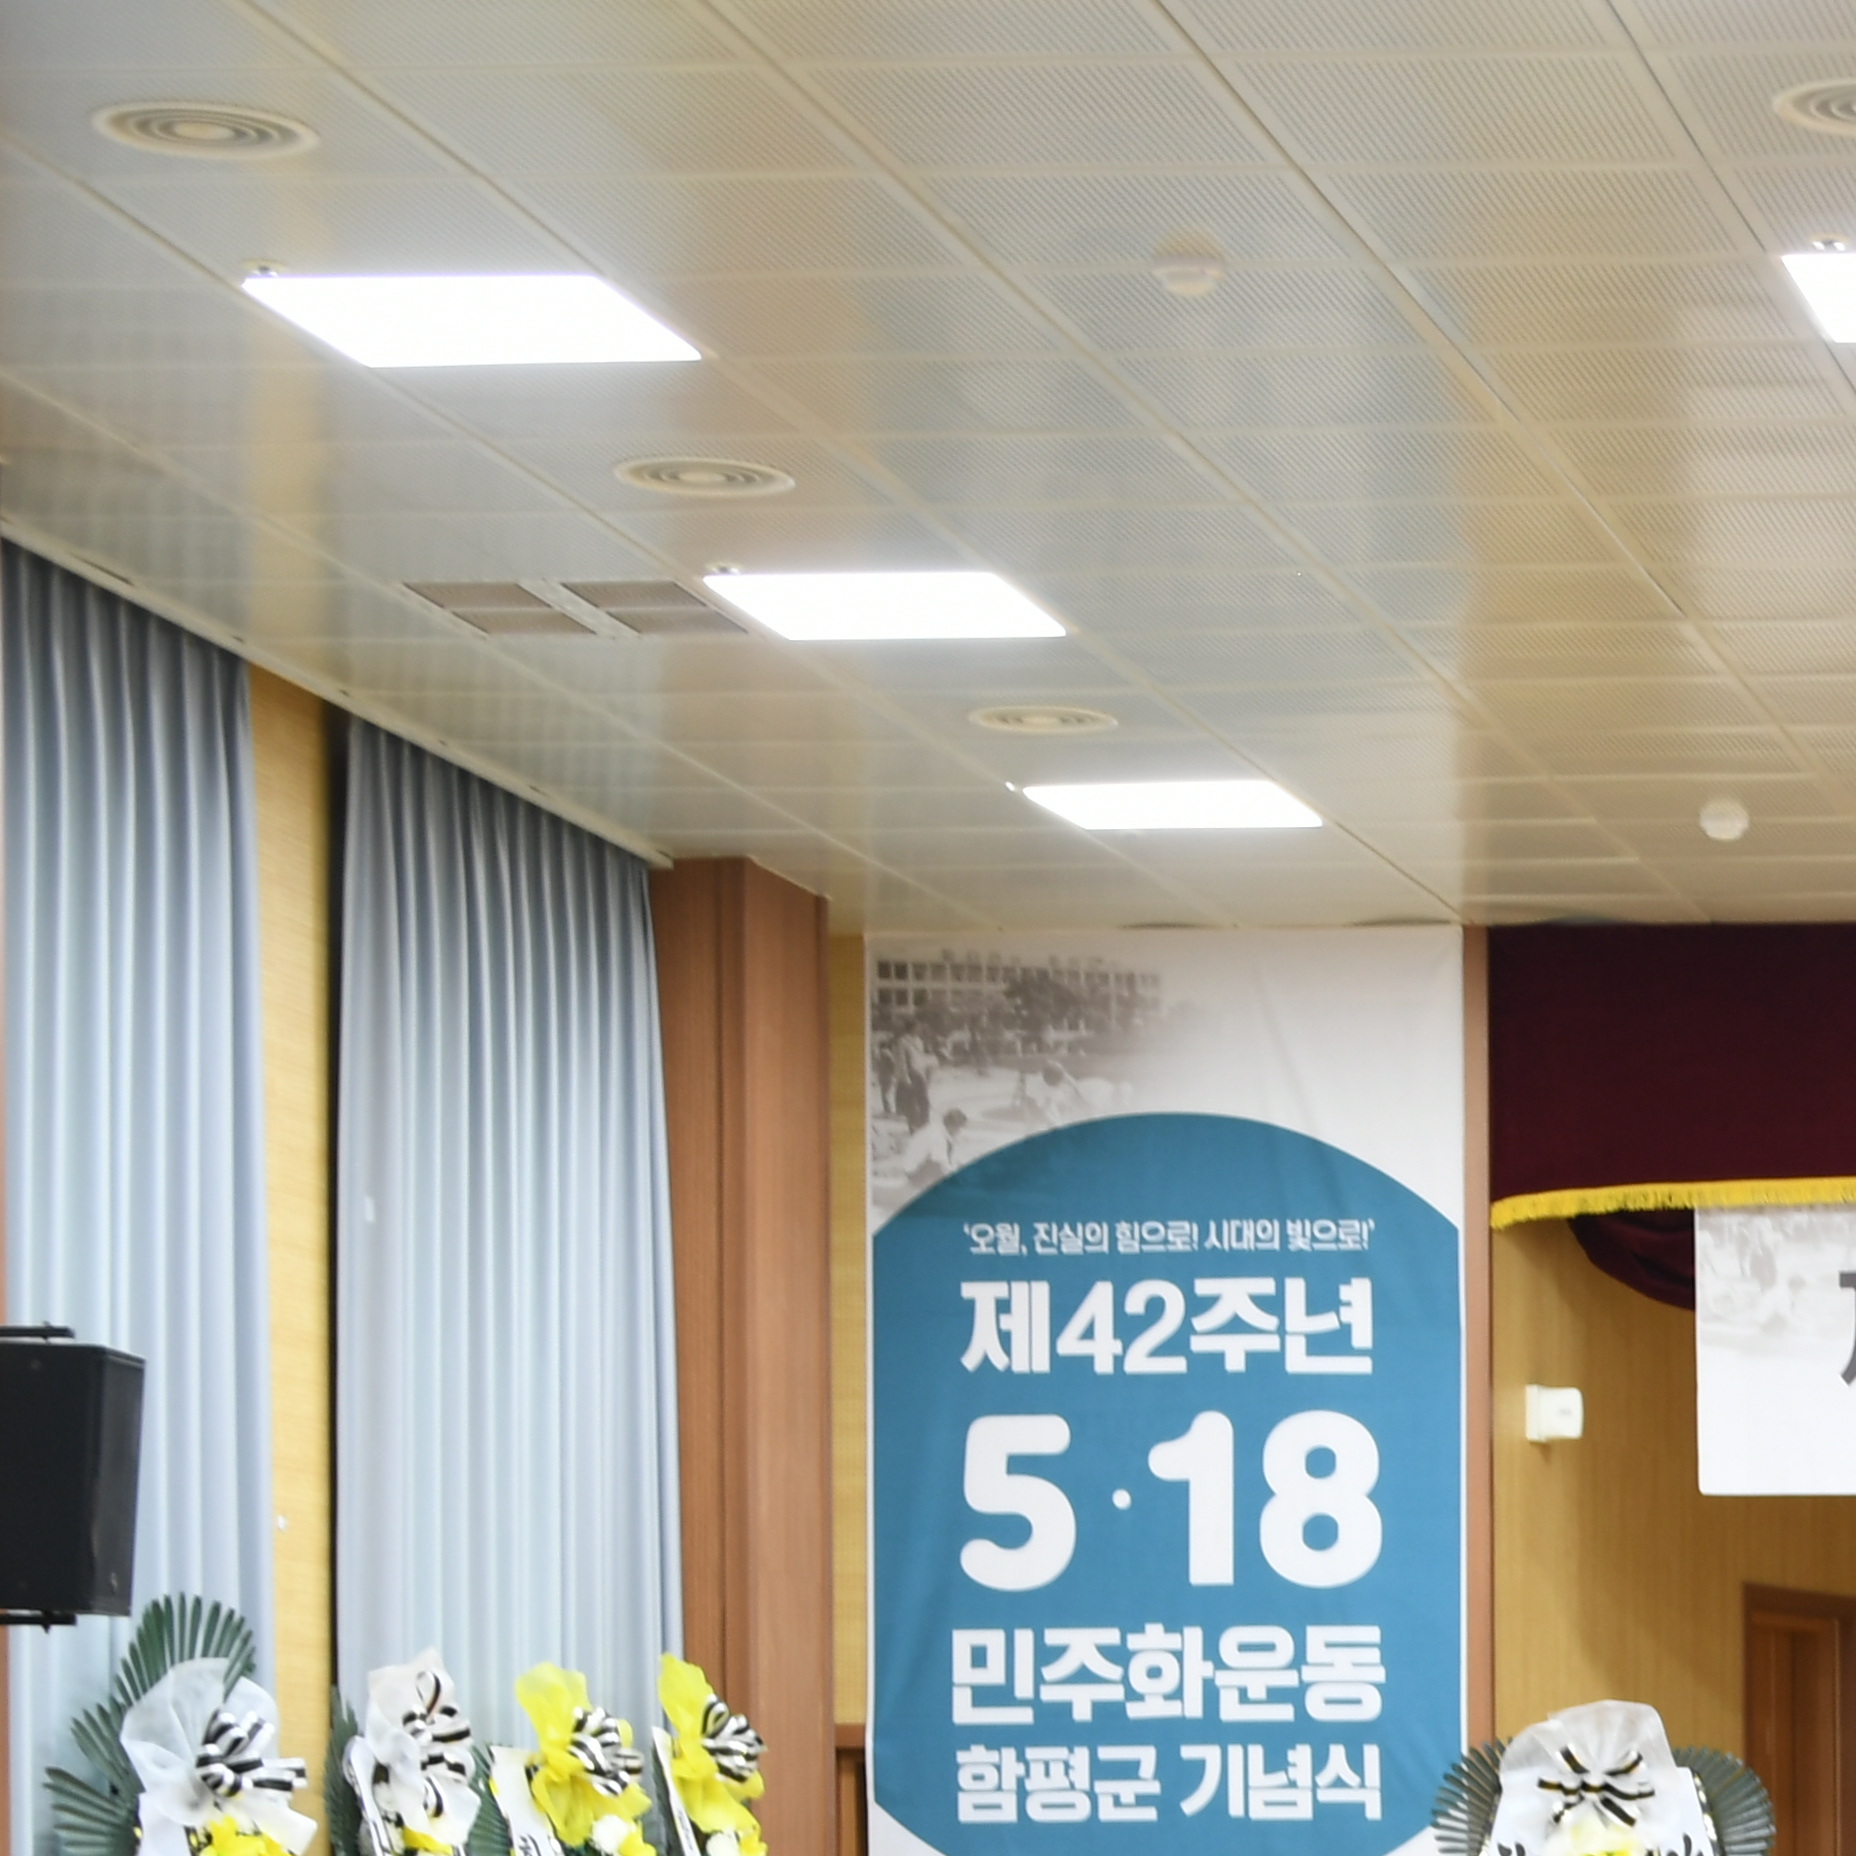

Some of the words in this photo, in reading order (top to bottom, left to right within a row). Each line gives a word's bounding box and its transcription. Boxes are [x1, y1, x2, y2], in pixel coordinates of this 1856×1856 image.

[1032, 1220, 1109, 1256] 진실의
[1114, 1219, 1199, 1255] 힘으로!
[1203, 1218, 1281, 1253] 시대의
[959, 1276, 1375, 1375] 제42주년
[951, 1622, 1387, 1726] 민주화운동
[955, 1744, 1163, 1824] 함평군
[1180, 1743, 1384, 1823] 기념식
